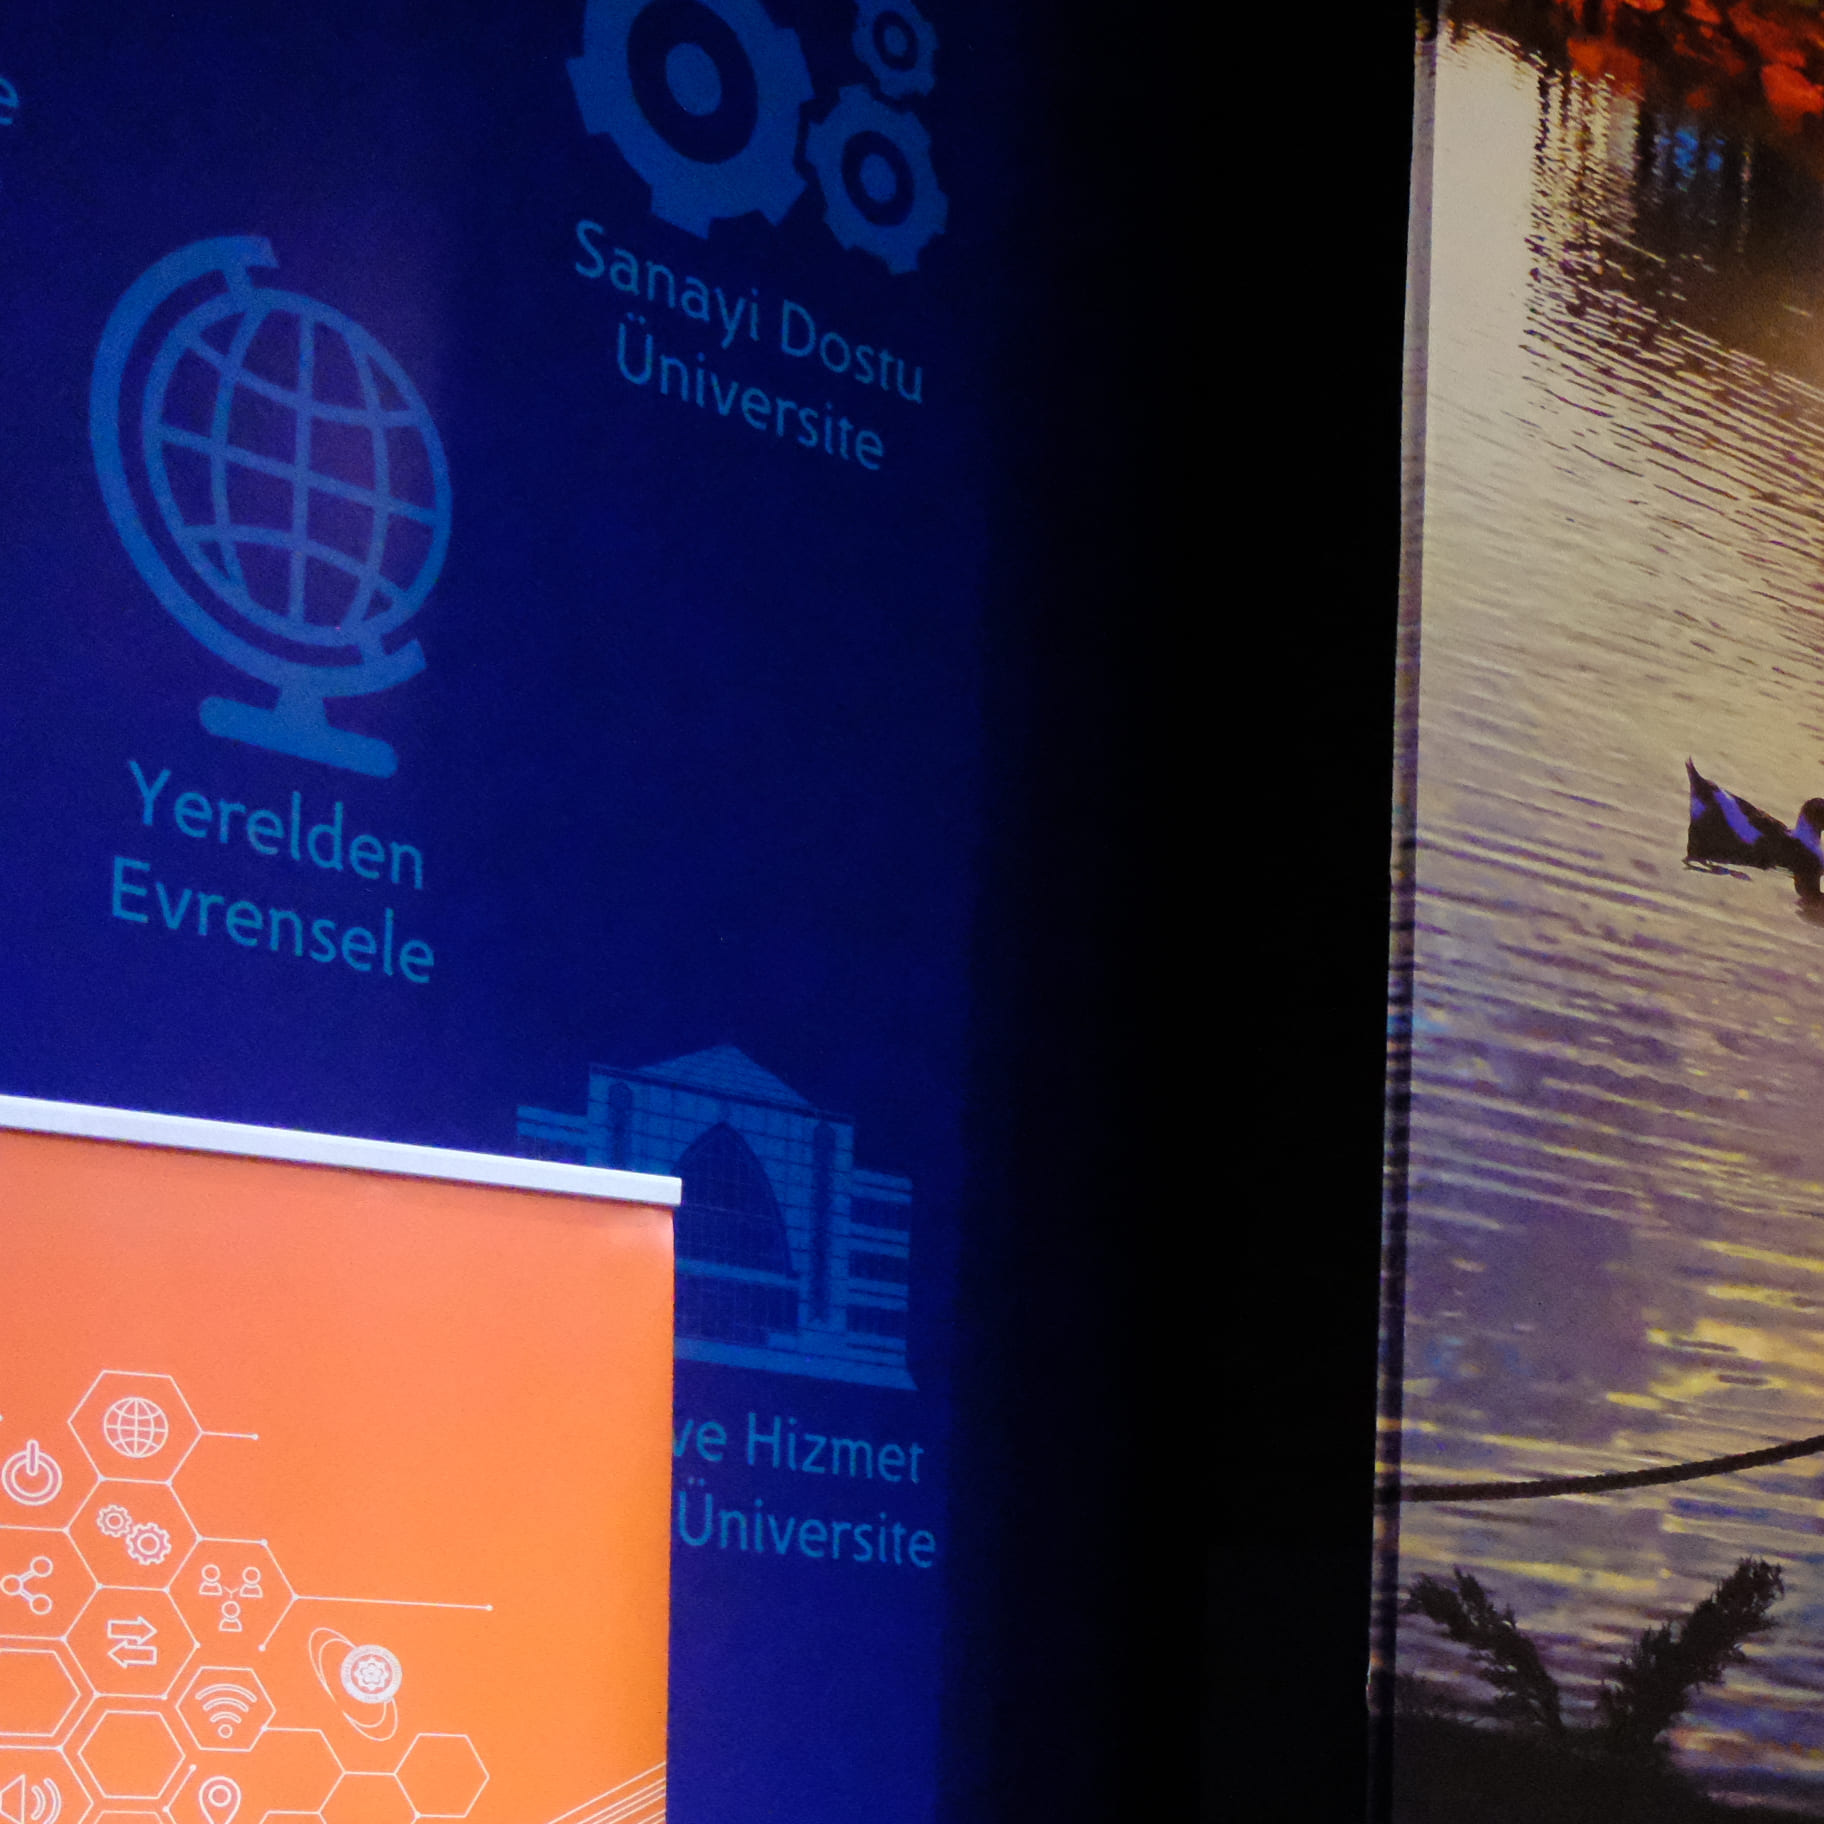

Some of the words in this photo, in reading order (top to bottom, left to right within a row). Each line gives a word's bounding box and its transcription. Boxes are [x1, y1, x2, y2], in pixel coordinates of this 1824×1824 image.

[575, 219, 759, 350] Sanayi
[781, 299, 922, 404] Dostu
[617, 312, 885, 470] Üniversite
[128, 759, 424, 890] Yerelden
[112, 855, 435, 984] Evrensele
[747, 1412, 925, 1484] Hizmet
[677, 1476, 938, 1569] Üniversite
